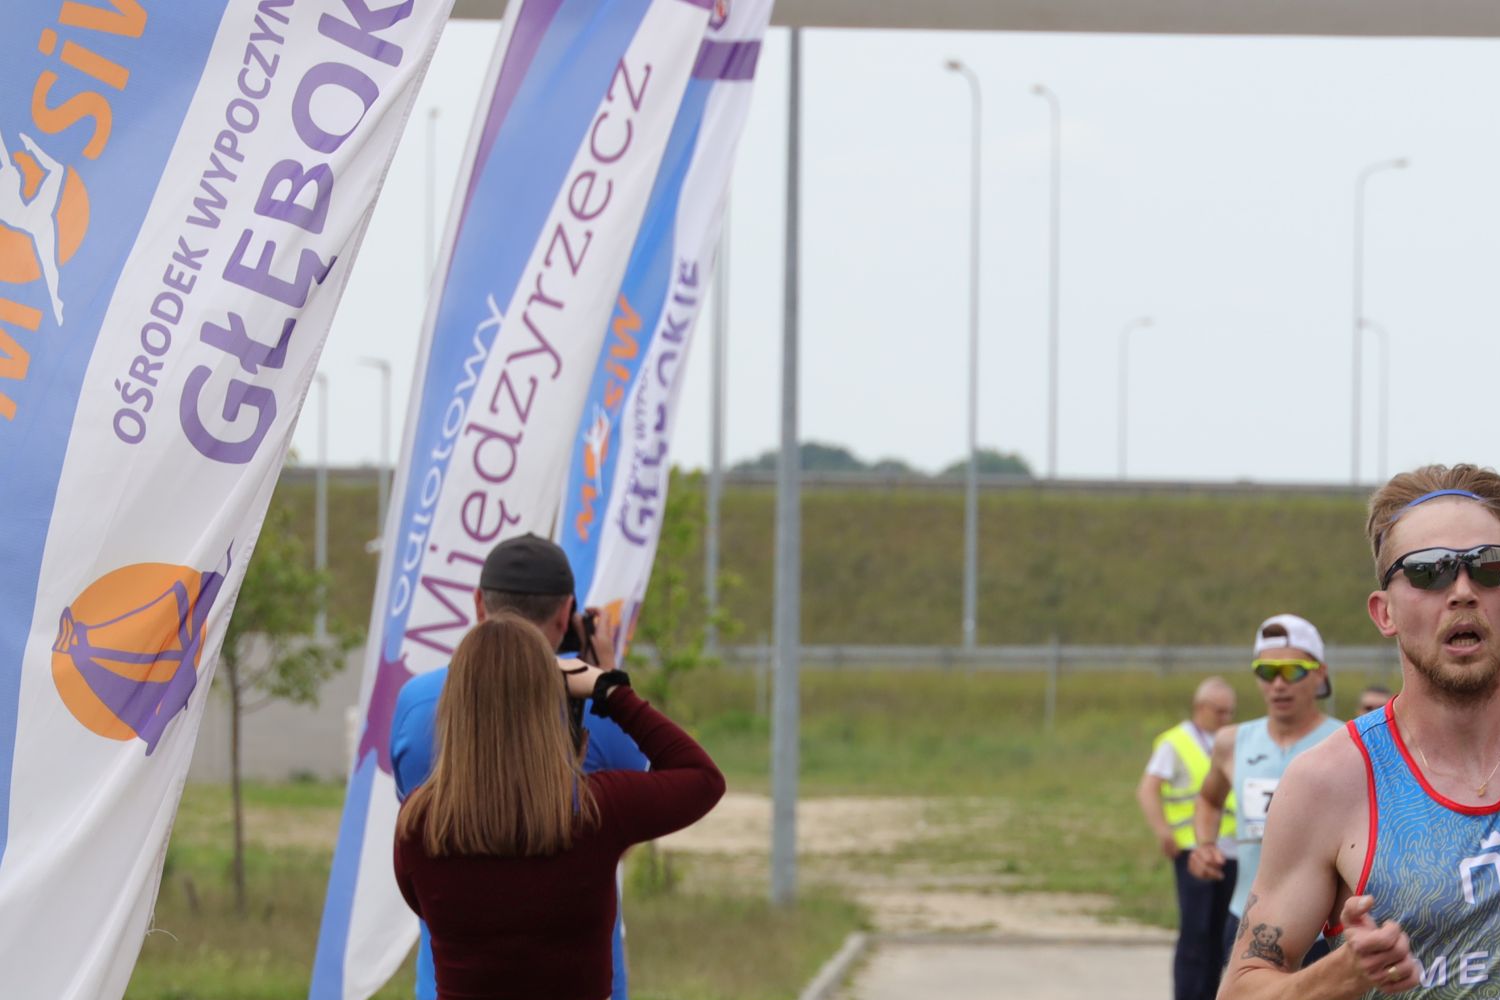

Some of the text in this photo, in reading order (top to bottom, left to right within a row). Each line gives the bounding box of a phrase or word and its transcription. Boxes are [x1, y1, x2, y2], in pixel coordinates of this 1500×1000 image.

[112, 235, 210, 445] OŚRODEK
[178, 0, 415, 465] GŁĘBOK
[403, 56, 653, 656] Międzyrzecz
[391, 293, 505, 618] odlotowy
